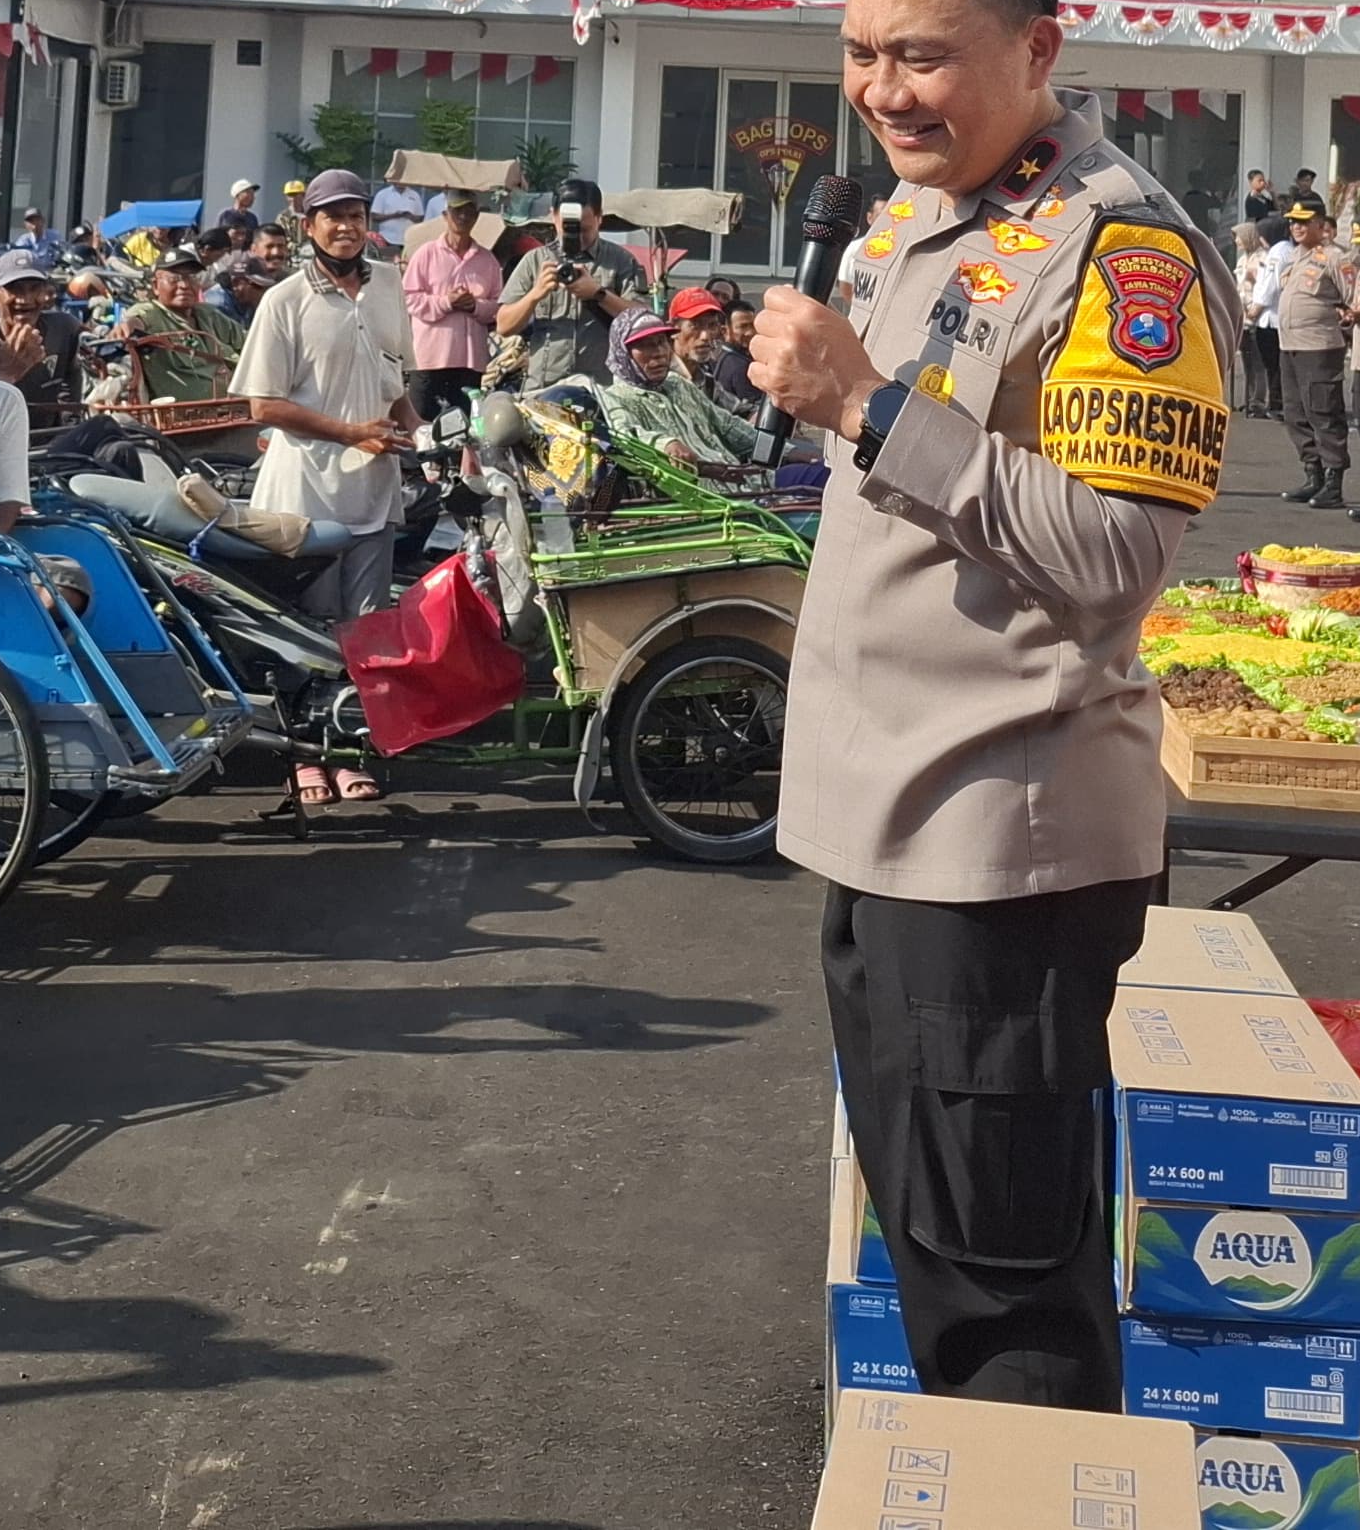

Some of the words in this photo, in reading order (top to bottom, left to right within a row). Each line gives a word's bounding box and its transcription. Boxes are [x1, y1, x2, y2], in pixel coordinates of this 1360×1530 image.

[735, 121, 773, 147] BAG
[789, 123, 828, 150] OPS
[925, 298, 1001, 357] POLRI
[1065, 439, 1147, 469] MANTAP
[1150, 447, 1201, 485] PRAJA
[1148, 1165, 1165, 1177] 24
[1167, 1166, 1177, 1178] X
[1180, 1167, 1206, 1180] 600
[1208, 1169, 1224, 1181] ml
[1210, 1231, 1297, 1268] AQUA
[852, 1362, 868, 1374] 24
[871, 1363, 880, 1375] X
[883, 1364, 908, 1377] 600
[1143, 1387, 1159, 1400] 24
[1162, 1388, 1171, 1401] X
[1174, 1390, 1200, 1403] 600
[1203, 1392, 1219, 1405] ml
[1199, 1458, 1285, 1496] AQUA
